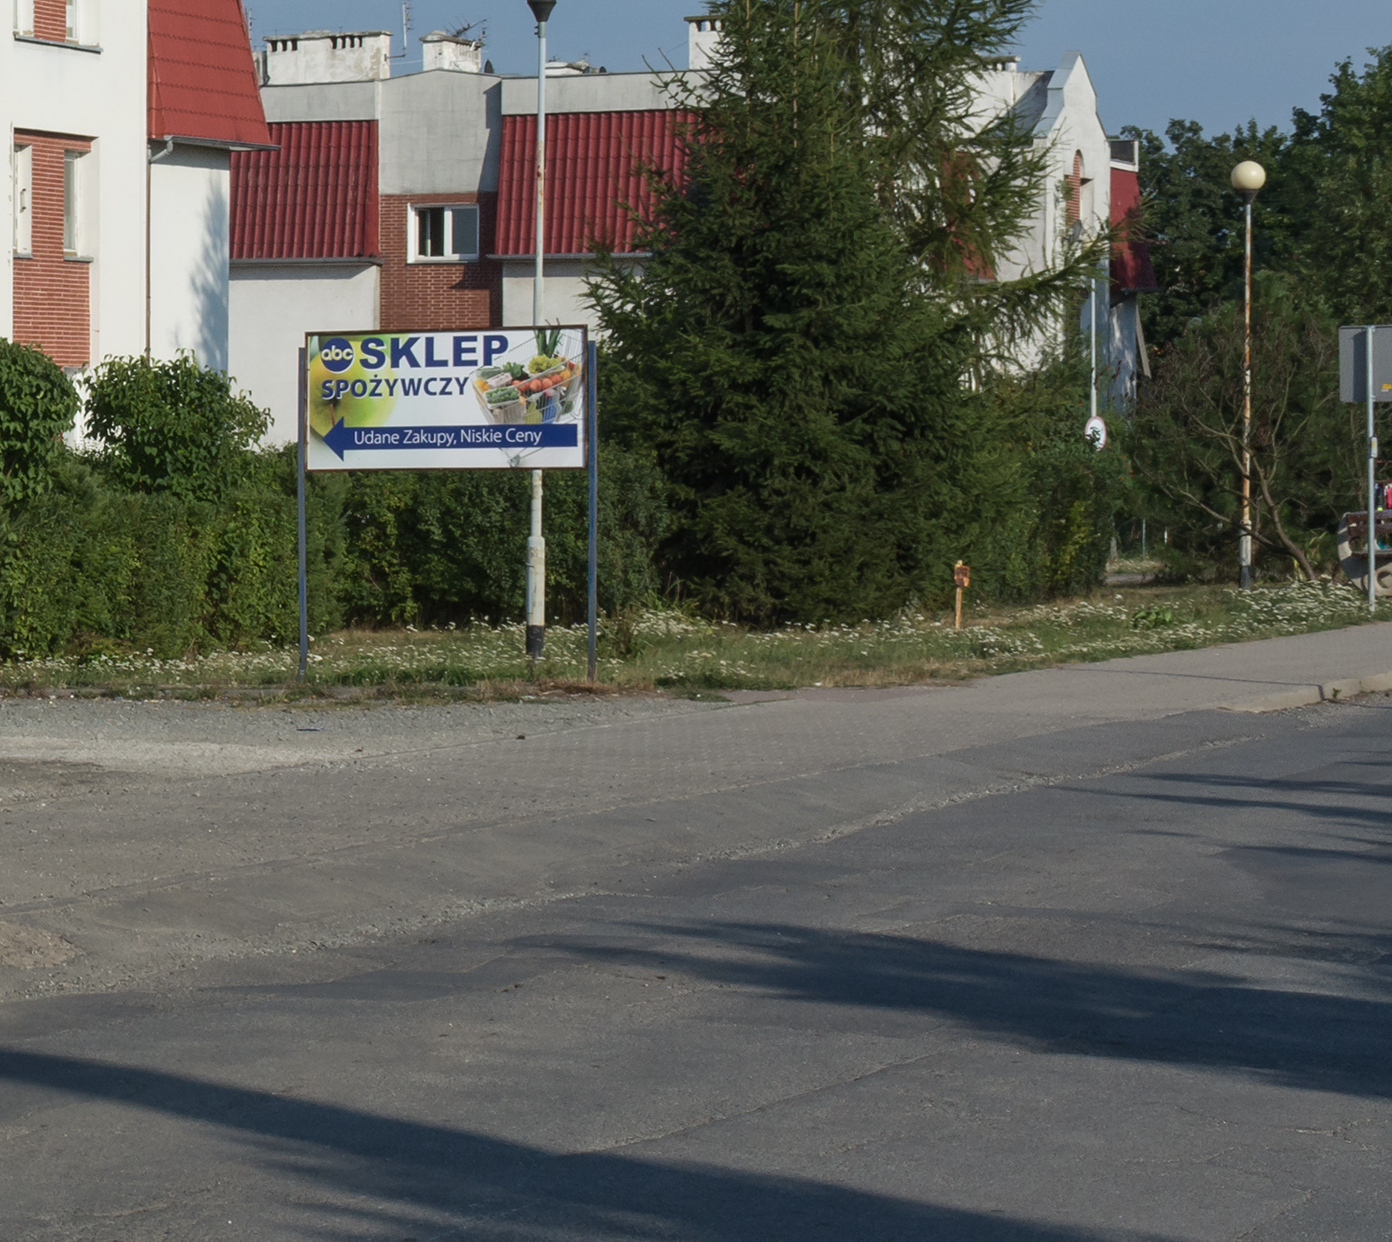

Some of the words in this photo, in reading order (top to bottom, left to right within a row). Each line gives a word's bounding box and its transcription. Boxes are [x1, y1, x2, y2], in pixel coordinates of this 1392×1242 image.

[321, 345, 353, 361] abc
[359, 335, 509, 370] SKLEP
[321, 374, 469, 399] SPOŻYWCZY
[354, 430, 400, 445] Udane
[403, 429, 457, 446] Zakupy,
[460, 428, 502, 443] Niskie
[505, 428, 542, 445] Ceny
